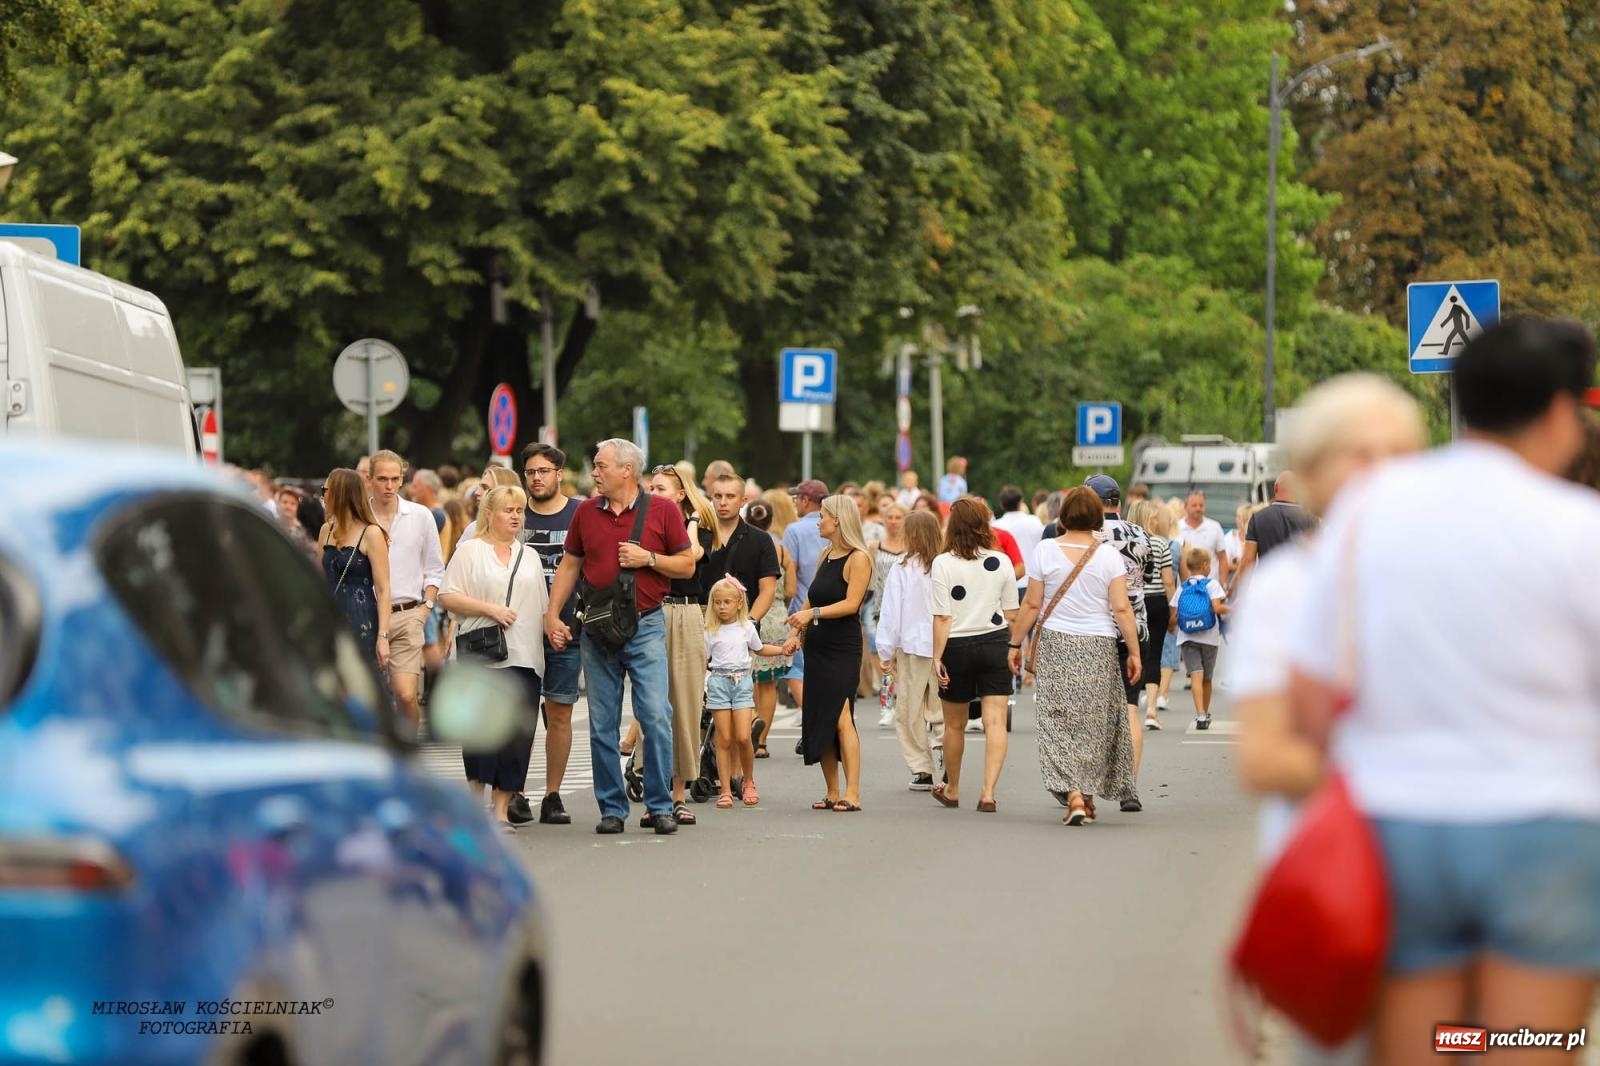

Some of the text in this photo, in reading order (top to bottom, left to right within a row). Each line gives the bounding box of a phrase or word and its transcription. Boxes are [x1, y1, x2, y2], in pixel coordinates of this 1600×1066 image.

[792, 355, 825, 397] P
[1086, 407, 1113, 443] P
[1185, 620, 1204, 629] FILA
